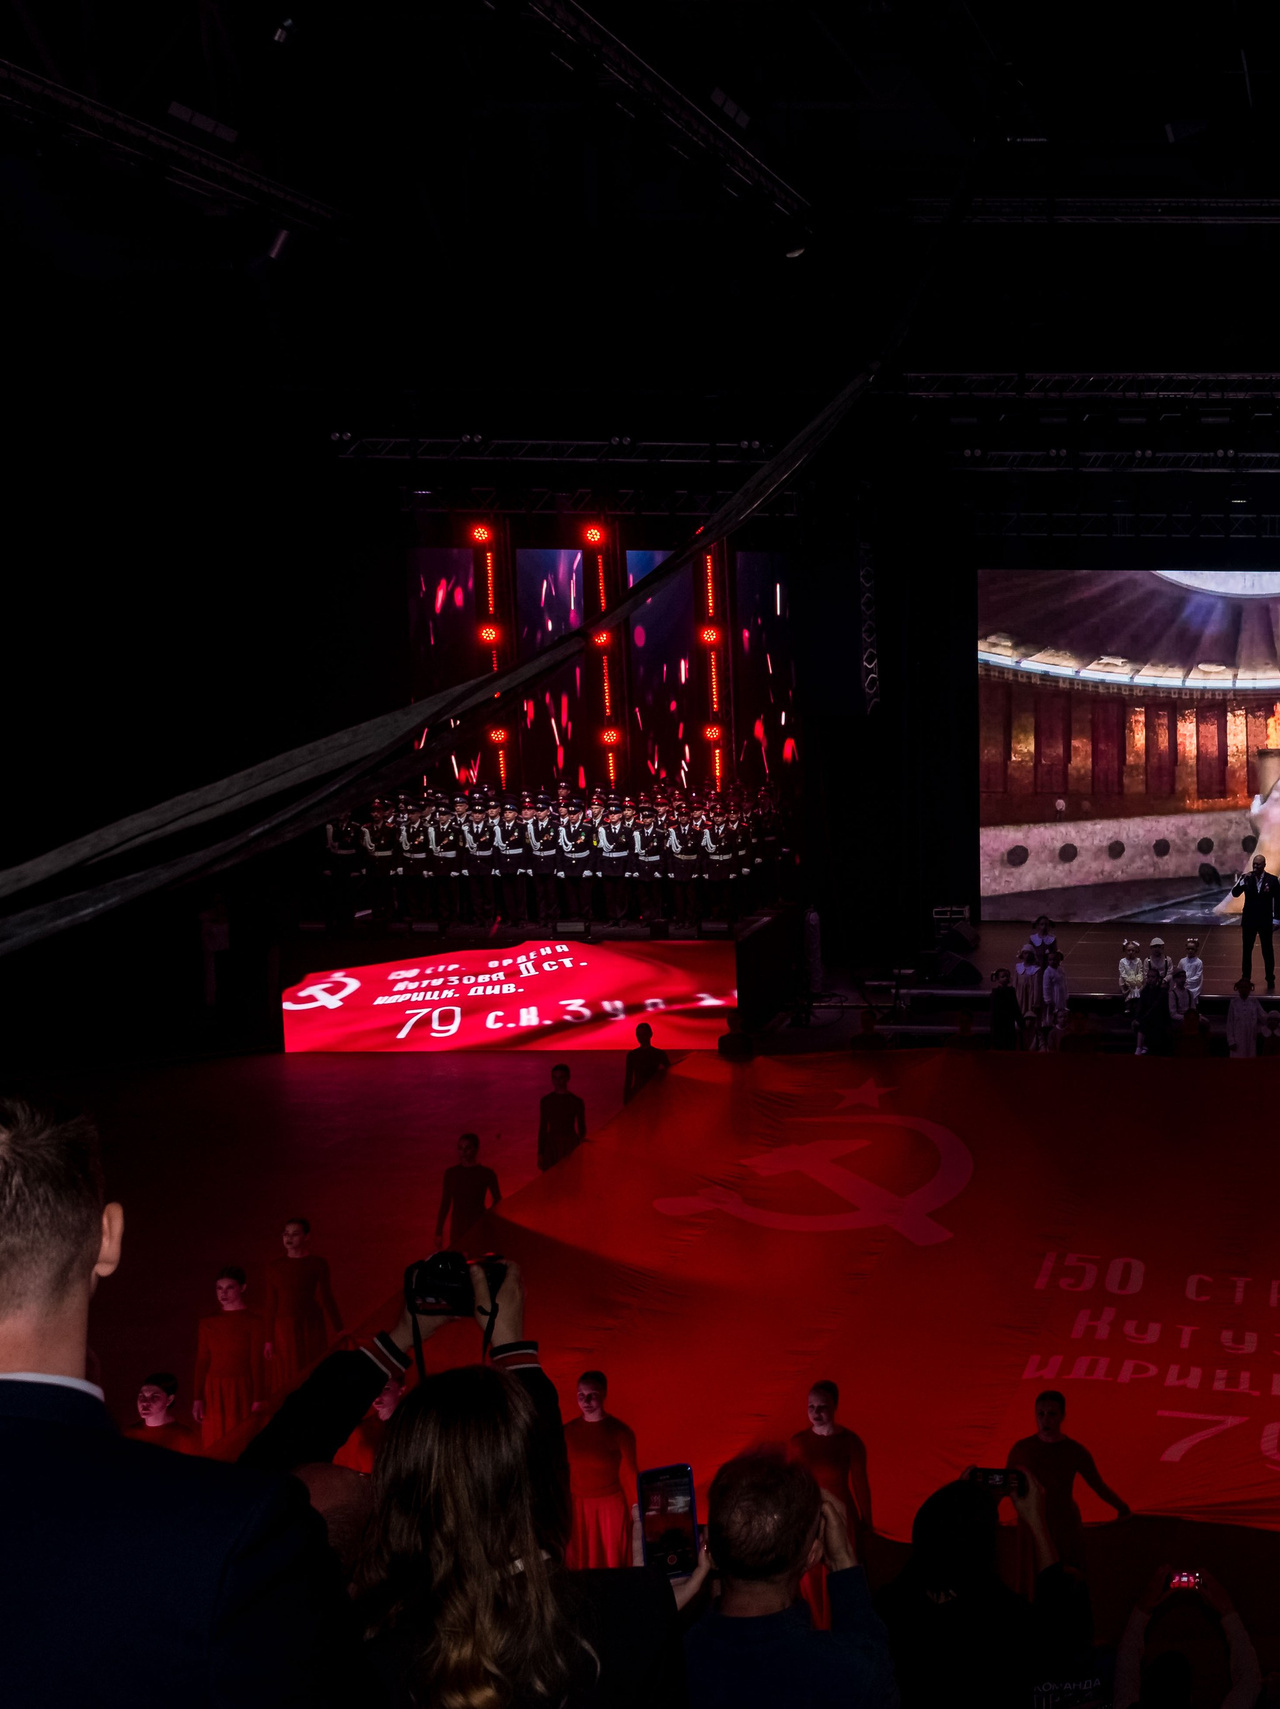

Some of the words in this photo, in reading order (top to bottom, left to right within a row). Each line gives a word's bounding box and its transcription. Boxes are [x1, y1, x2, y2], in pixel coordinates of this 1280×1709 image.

[488, 944, 569, 968] ОРДЕНА
[396, 1006, 461, 1039] 79
[1034, 1251, 1146, 1295] 150
